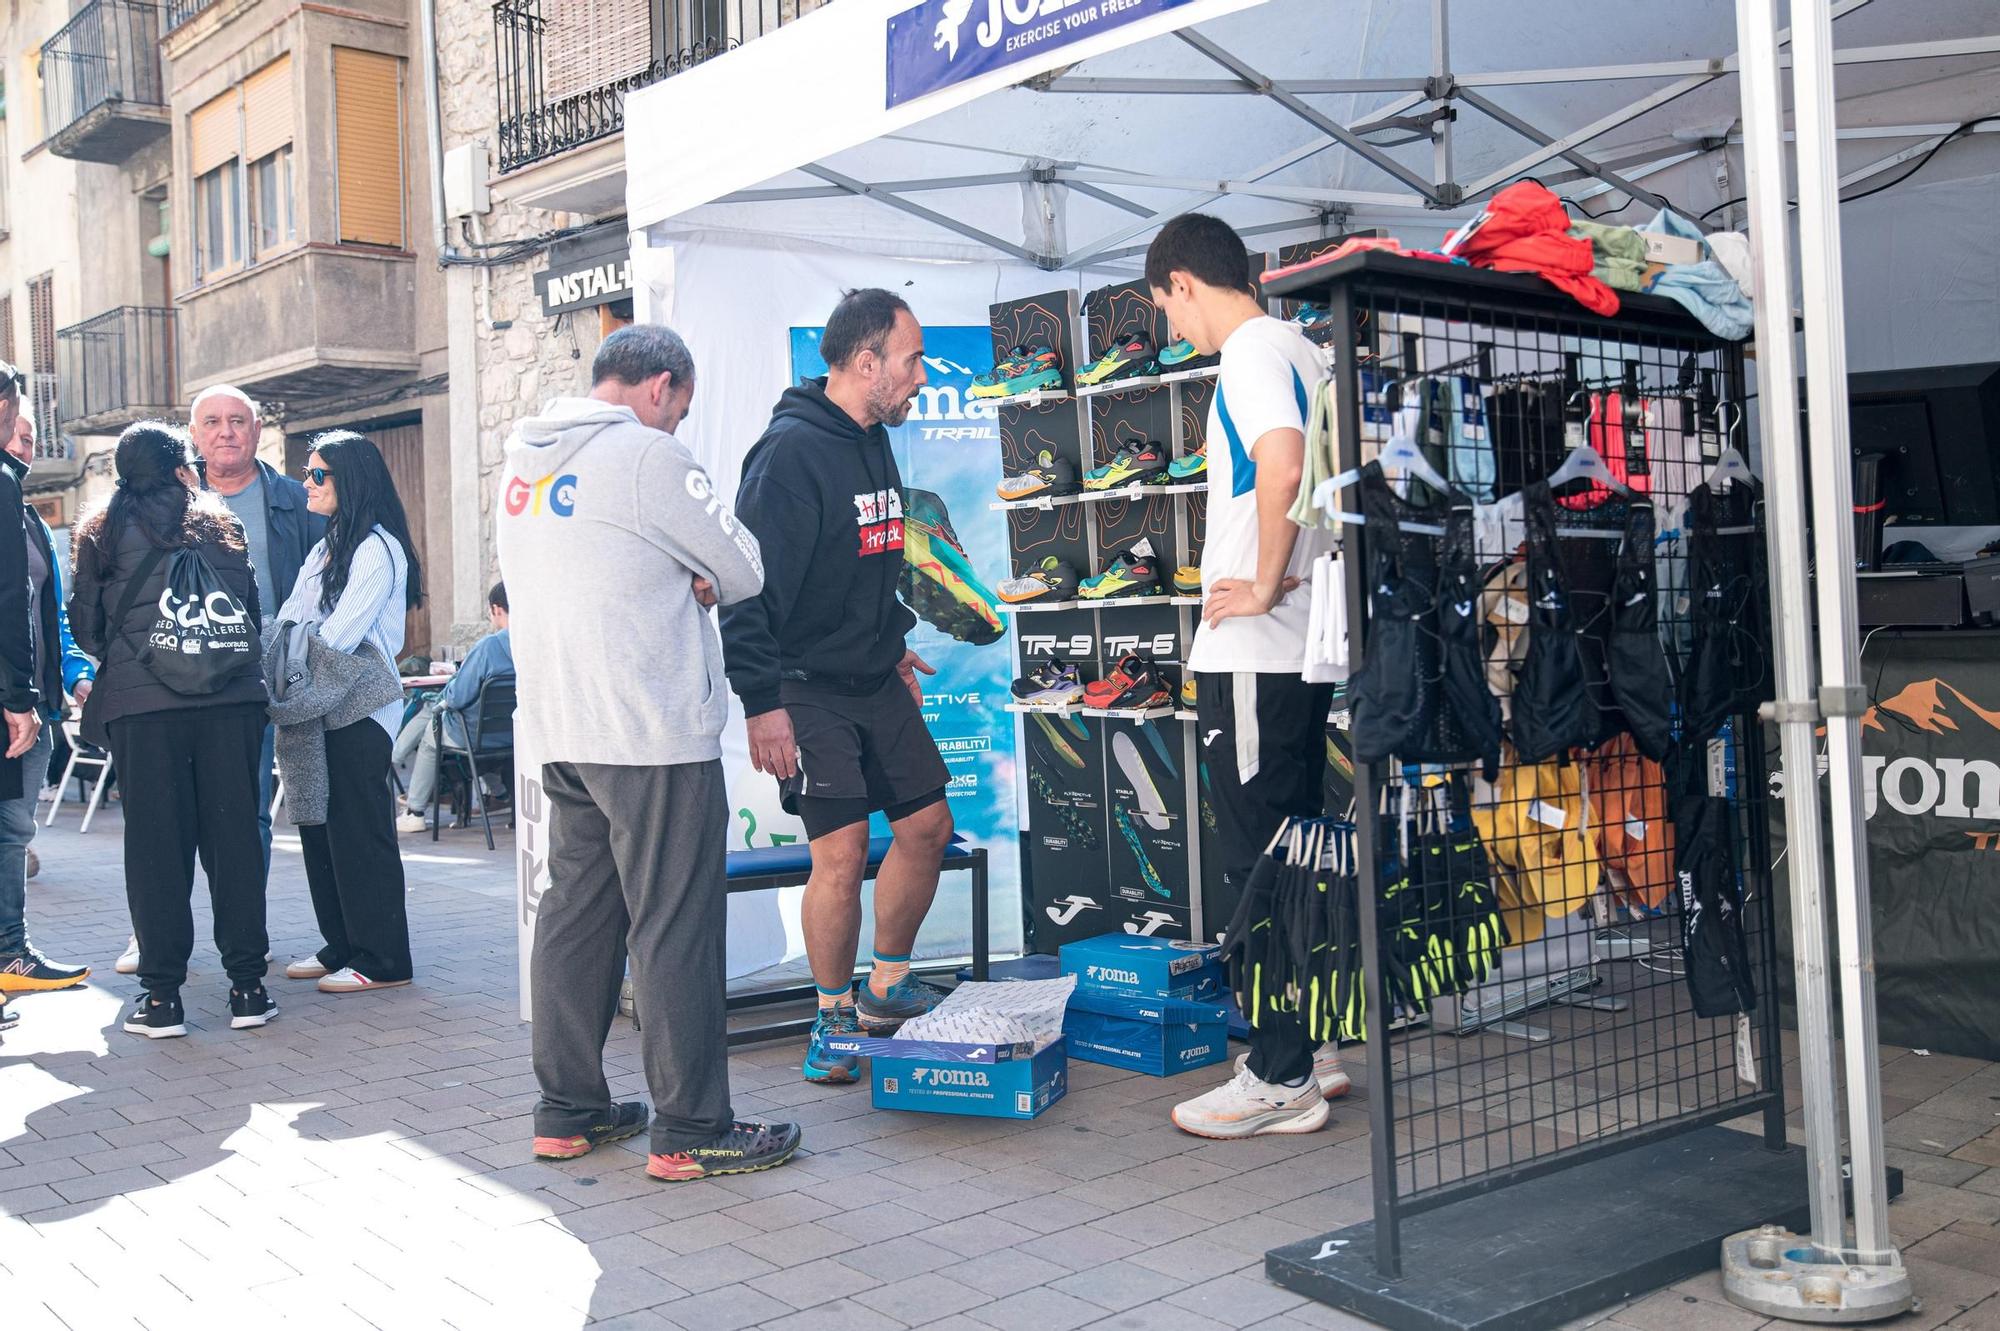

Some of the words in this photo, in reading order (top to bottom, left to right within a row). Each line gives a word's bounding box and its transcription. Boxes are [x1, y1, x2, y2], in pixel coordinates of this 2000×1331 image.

[1006, 20, 1061, 52] EXERCISE
[1063, 6, 1098, 30] YOUR
[920, 427, 1000, 441] TRAIL
[505, 474, 578, 518] GTC
[156, 620, 173, 630] RED
[193, 625, 247, 637] TALLERES
[1021, 635, 1092, 655] TR-9
[1104, 634, 1175, 657] TR-6
[1098, 967, 1140, 985] Joma
[929, 1068, 990, 1087] Joma
[933, 1090, 968, 1098] PROFESSIONAL
